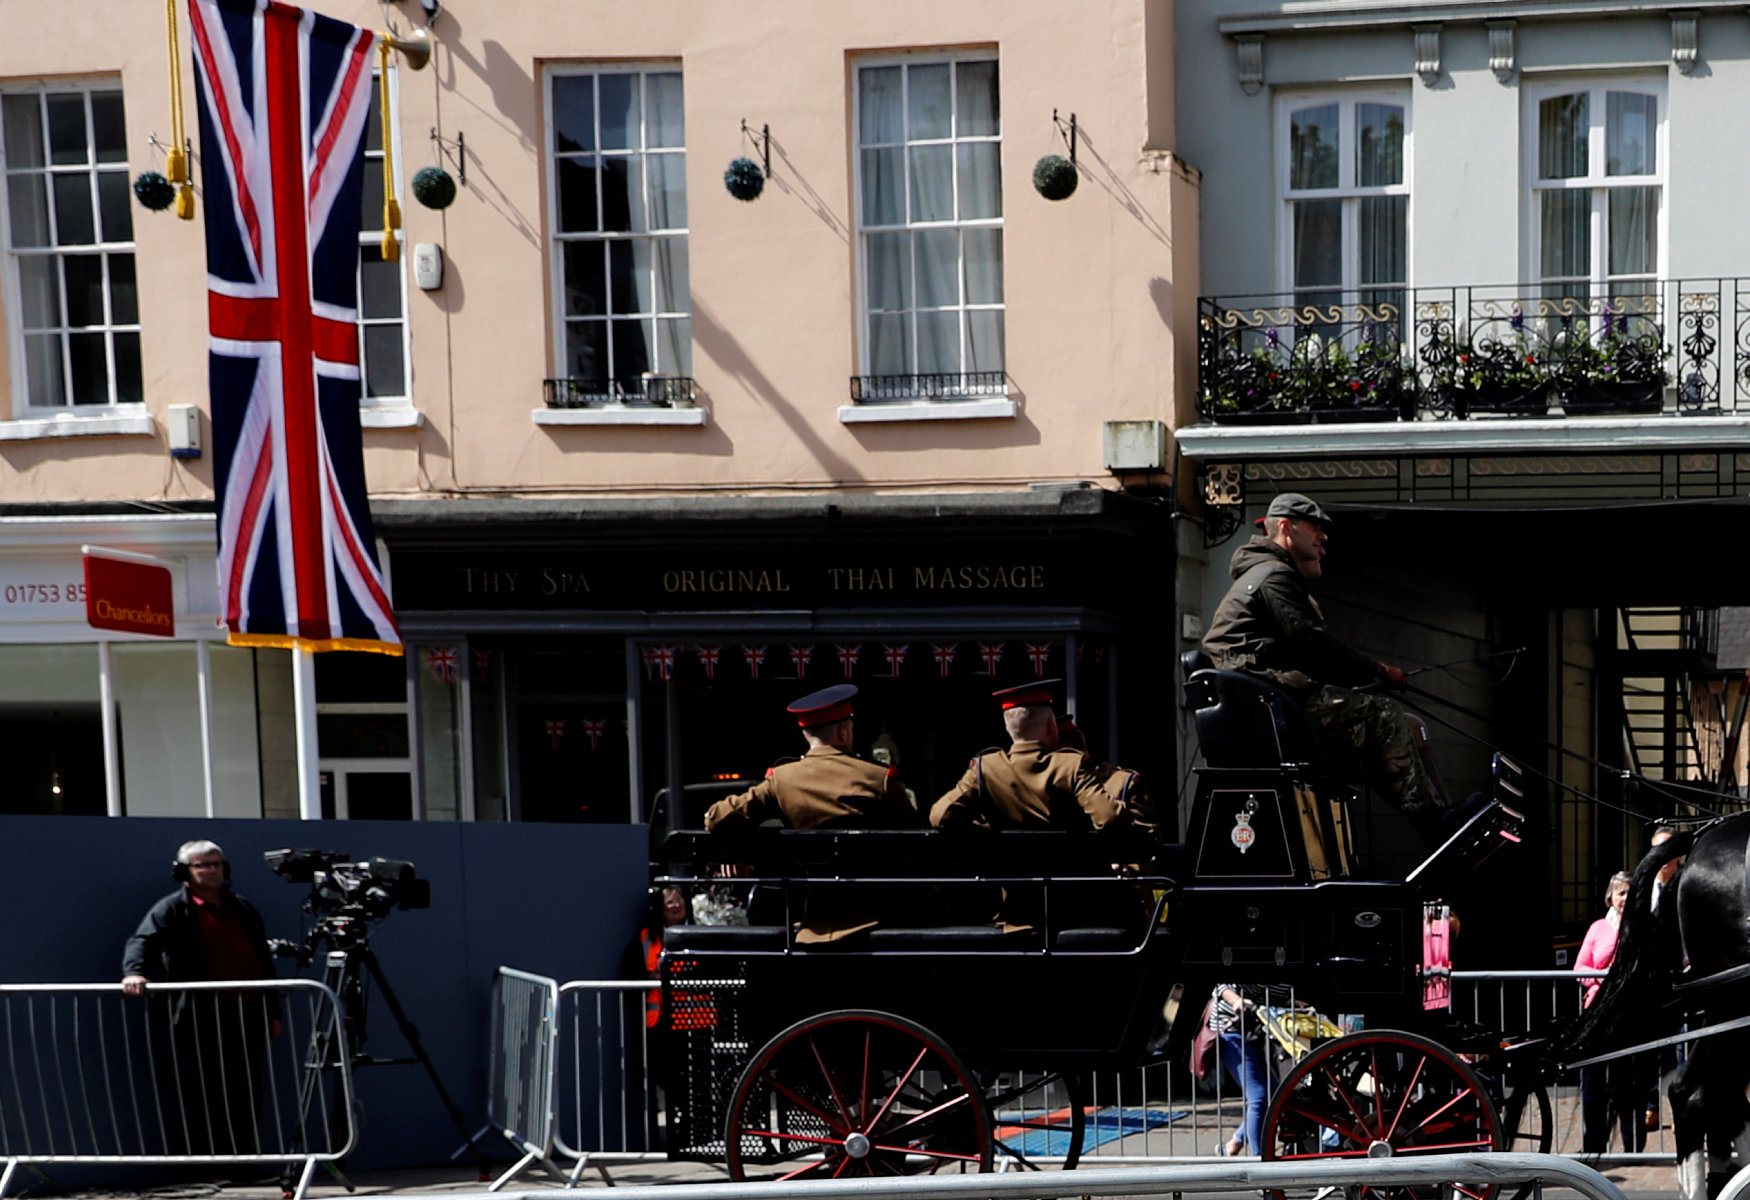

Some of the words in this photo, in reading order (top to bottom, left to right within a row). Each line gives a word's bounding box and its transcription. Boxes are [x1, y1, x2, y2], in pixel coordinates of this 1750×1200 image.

[663, 569, 790, 593] ORIGINAL
[828, 568, 894, 590] THAI
[915, 566, 1044, 589] MASSAGE
[5, 584, 60, 603] 01753
[66, 584, 87, 603] 85
[96, 599, 170, 627] Chancellors
